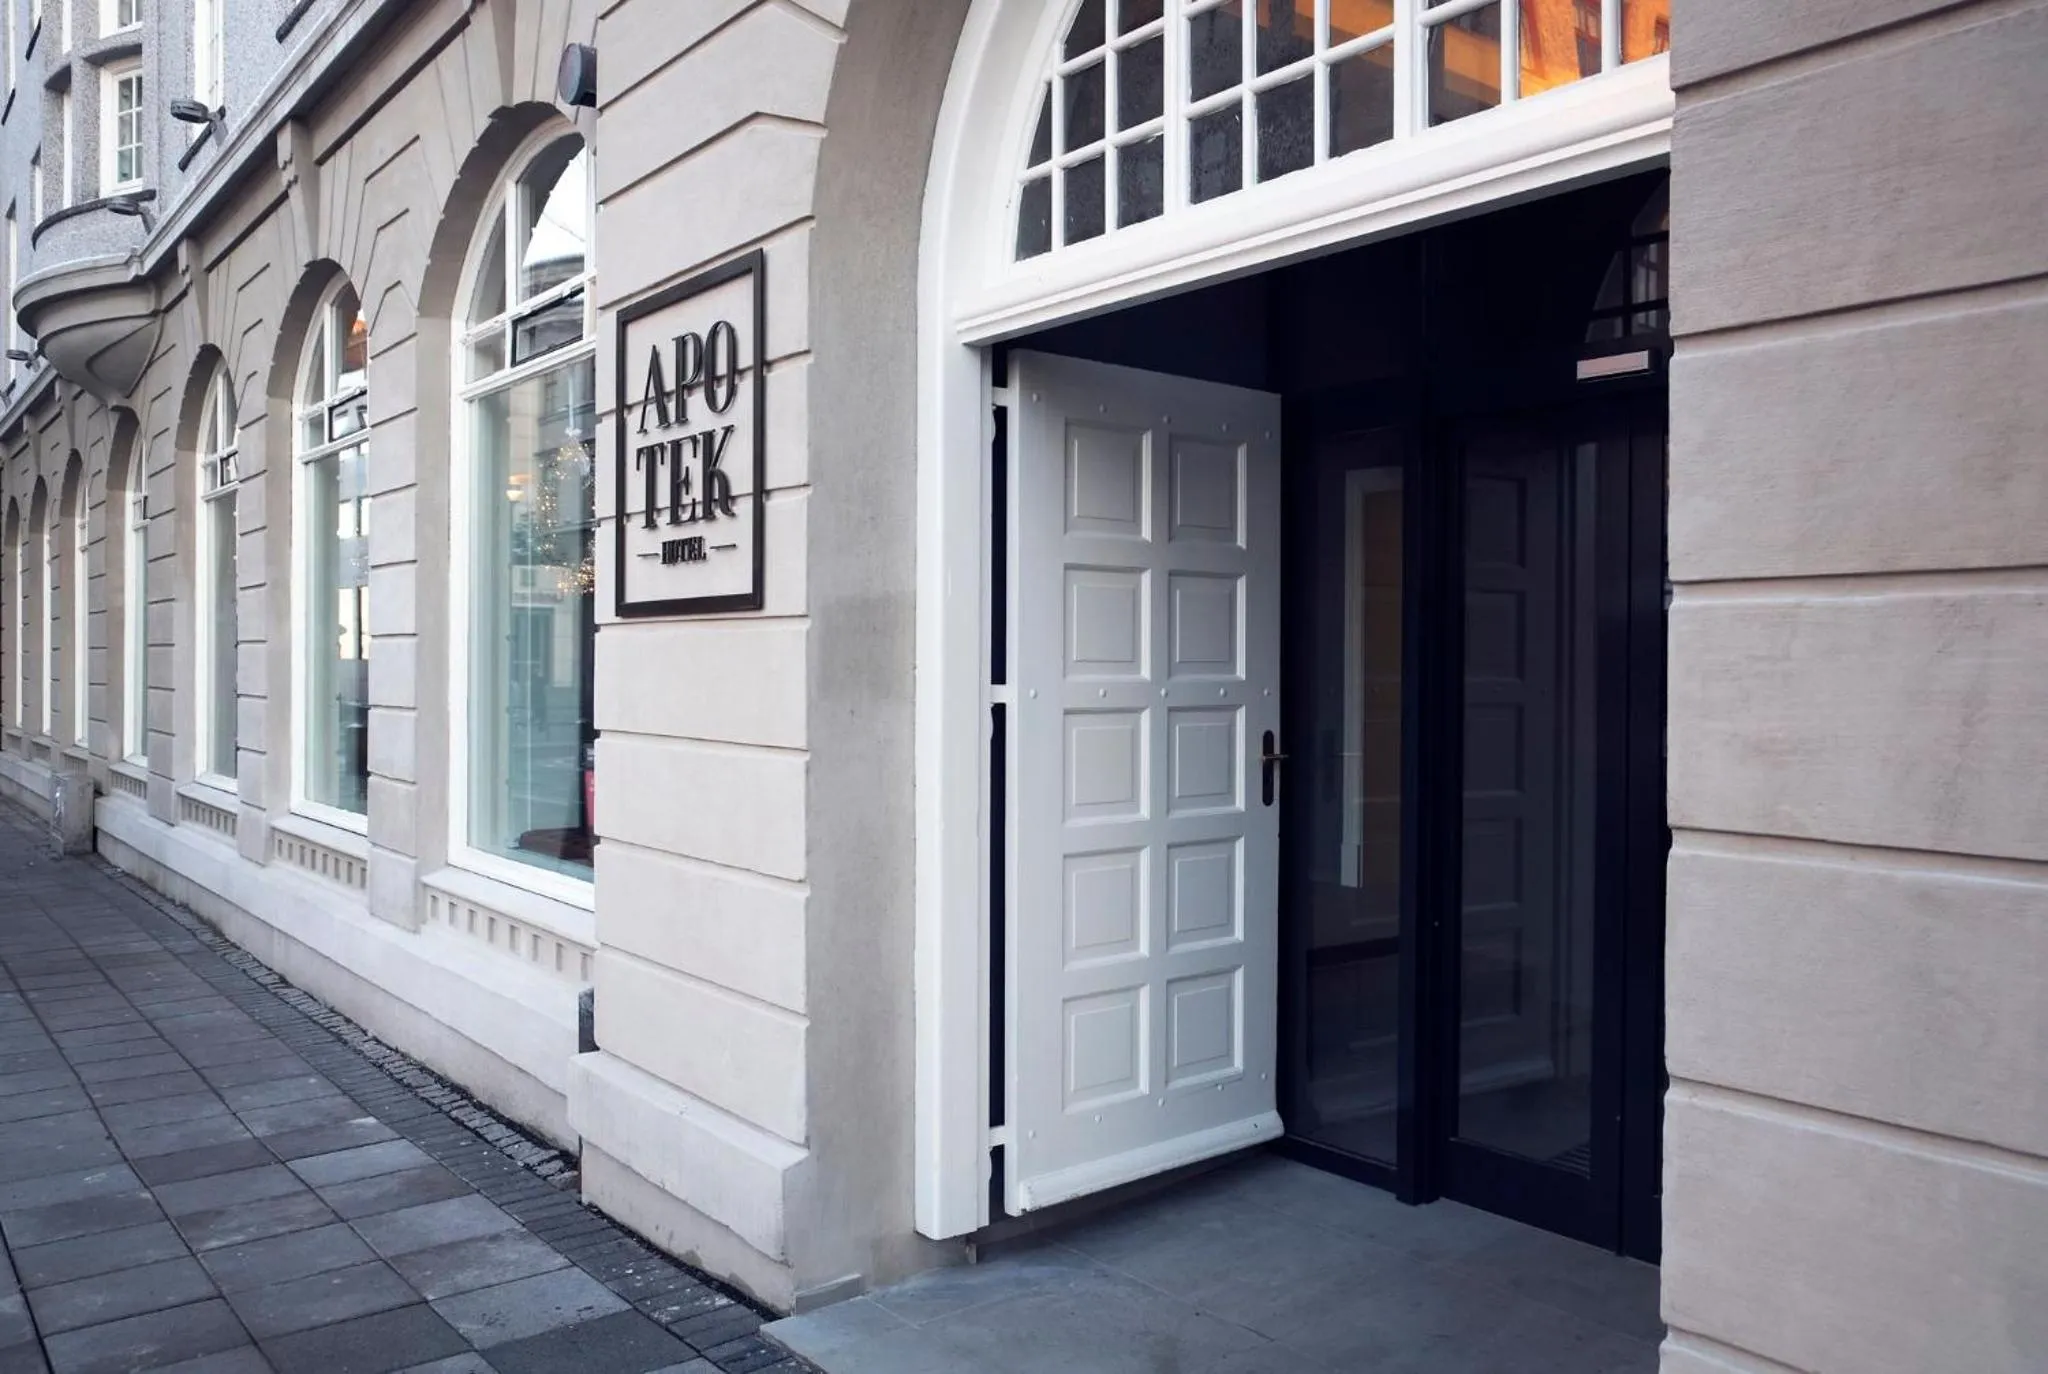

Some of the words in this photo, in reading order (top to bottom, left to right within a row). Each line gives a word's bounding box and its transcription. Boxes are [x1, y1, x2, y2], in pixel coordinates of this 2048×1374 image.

[636, 320, 737, 434] APO
[636, 424, 735, 529] TEK
[661, 535, 706, 564] HOTEL
